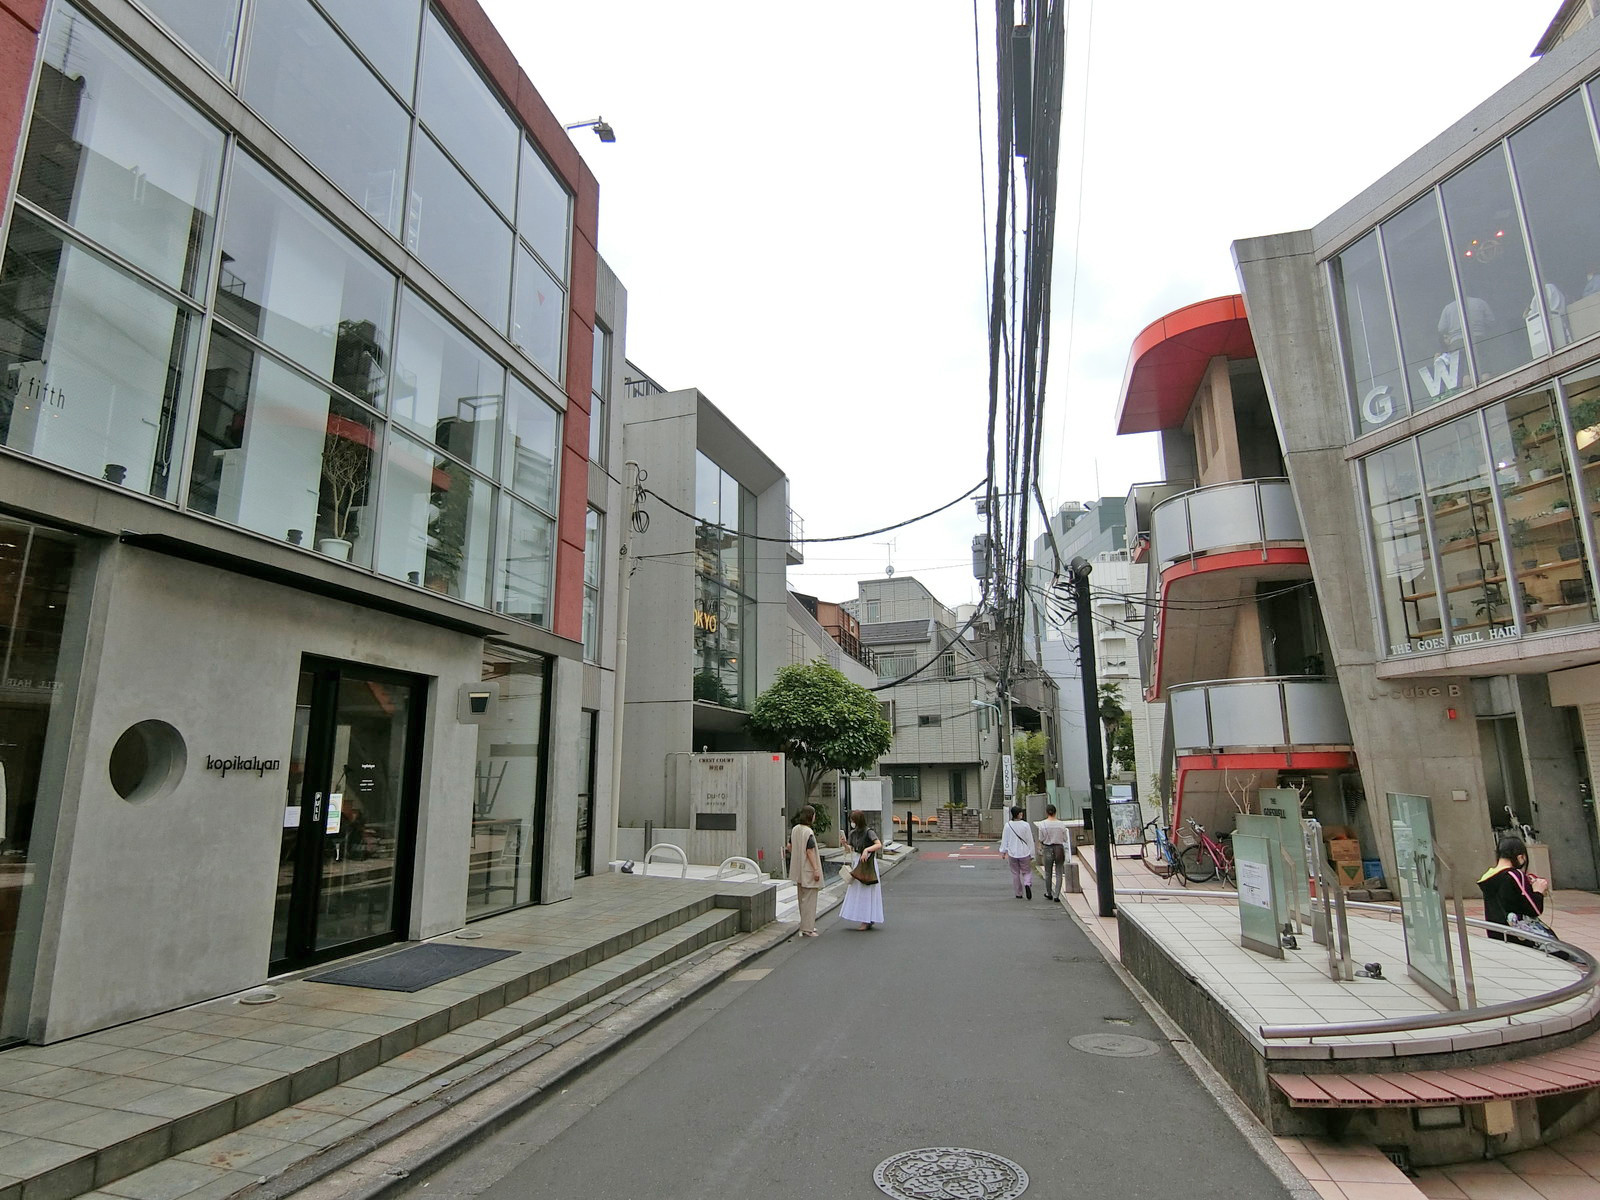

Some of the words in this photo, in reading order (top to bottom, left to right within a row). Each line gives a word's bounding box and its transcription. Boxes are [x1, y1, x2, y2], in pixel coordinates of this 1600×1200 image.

[28, 377, 66, 410] fifth
[1391, 642, 1413, 655] THE
[1417, 637, 1447, 652] GOES
[1453, 631, 1485, 646] WELL
[1489, 625, 1518, 640] HAIR
[1447, 684, 1462, 698] B
[205, 754, 281, 778] kopikalyan
